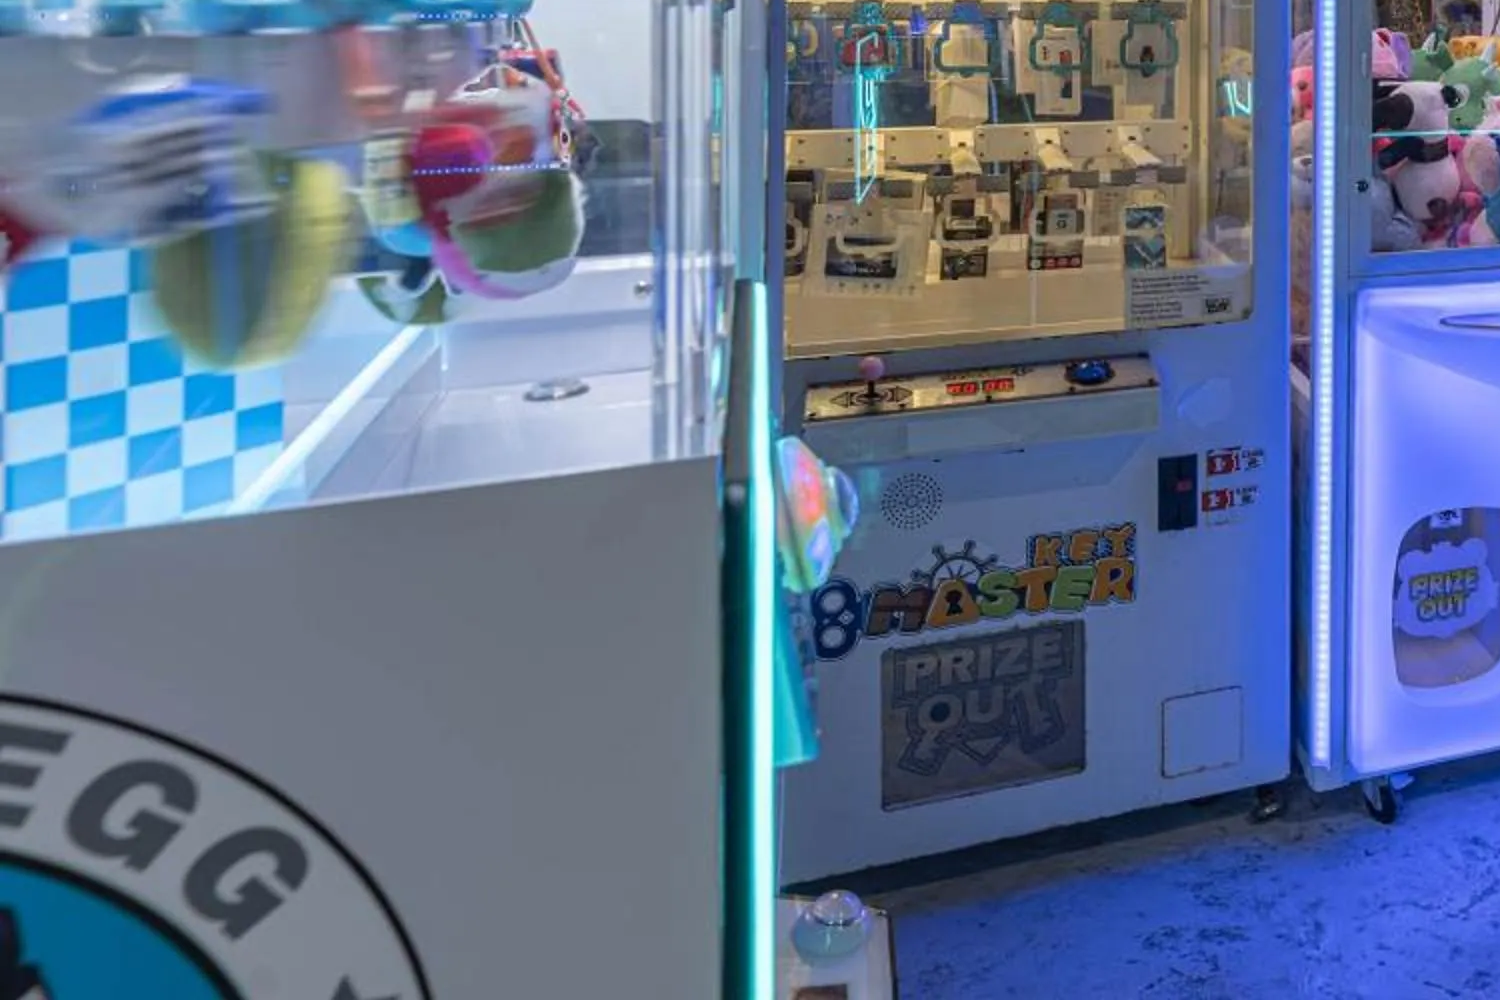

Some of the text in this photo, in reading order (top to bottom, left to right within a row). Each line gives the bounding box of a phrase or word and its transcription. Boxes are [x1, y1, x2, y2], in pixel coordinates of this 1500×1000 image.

[1034, 524, 1136, 567] KEY
[866, 556, 1135, 638] MASTER
[1409, 566, 1479, 602] PRIZE
[1416, 593, 1467, 622] OUT
[903, 629, 1065, 692] PRIZE
[0, 722, 309, 942] EGG
